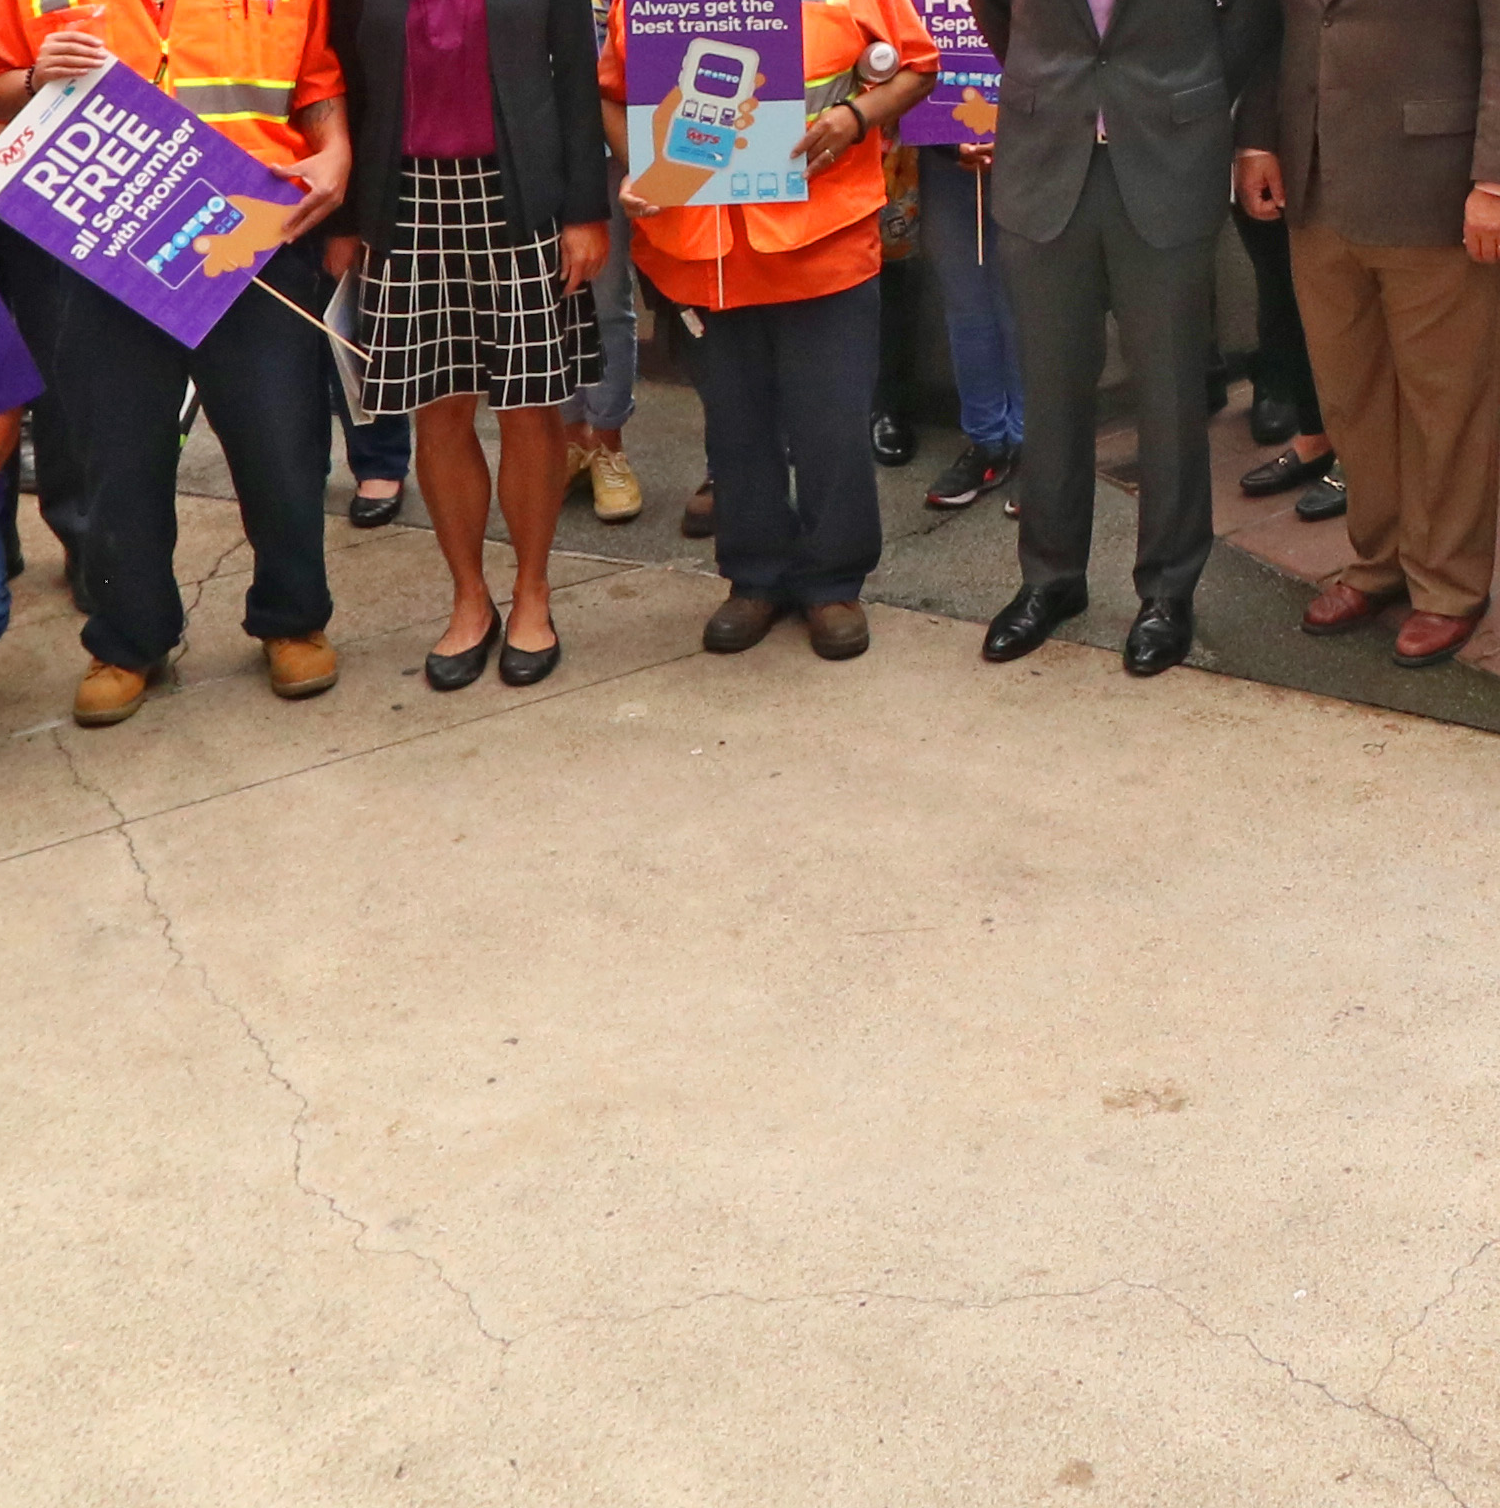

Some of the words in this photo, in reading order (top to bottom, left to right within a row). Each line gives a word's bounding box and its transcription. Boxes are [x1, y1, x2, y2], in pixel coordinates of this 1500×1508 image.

[630, 0, 700, 17] Always
[705, 0, 737, 17] get
[632, 19, 674, 34] best
[678, 16, 741, 33] transit
[745, 15, 788, 31] fare.
[22, 94, 126, 200] RIDE
[52, 114, 161, 226] FREE
[70, 228, 100, 260] all
[92, 118, 196, 233] September
[103, 219, 140, 258] with
[134, 146, 203, 221] PRONTO!
[146, 195, 226, 273] PRONTO
